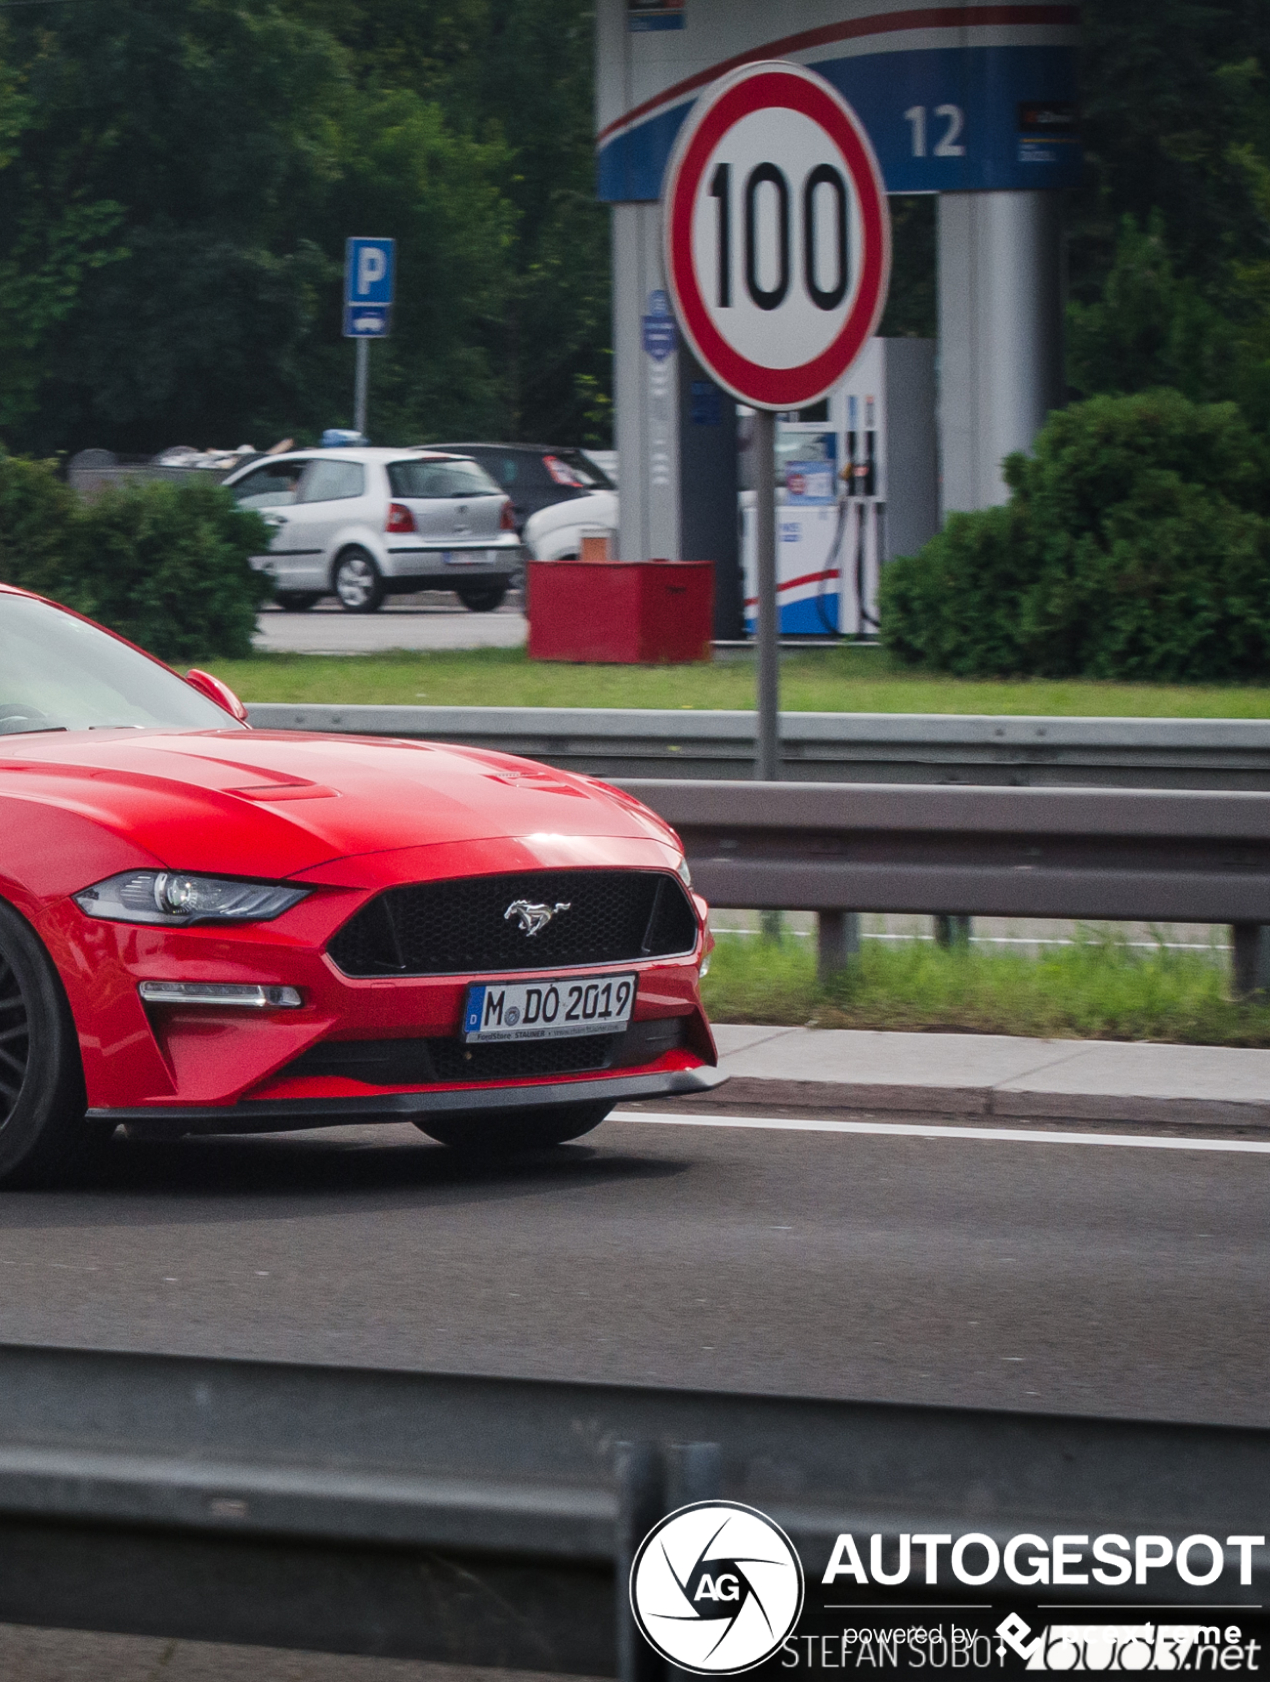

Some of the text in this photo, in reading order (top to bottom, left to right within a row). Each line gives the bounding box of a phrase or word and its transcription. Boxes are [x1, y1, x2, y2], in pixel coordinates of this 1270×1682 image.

[904, 104, 965, 157] 12
[707, 162, 850, 311] 100
[357, 247, 387, 294] P
[484, 990, 506, 1026] M
[565, 981, 631, 1021] 2019
